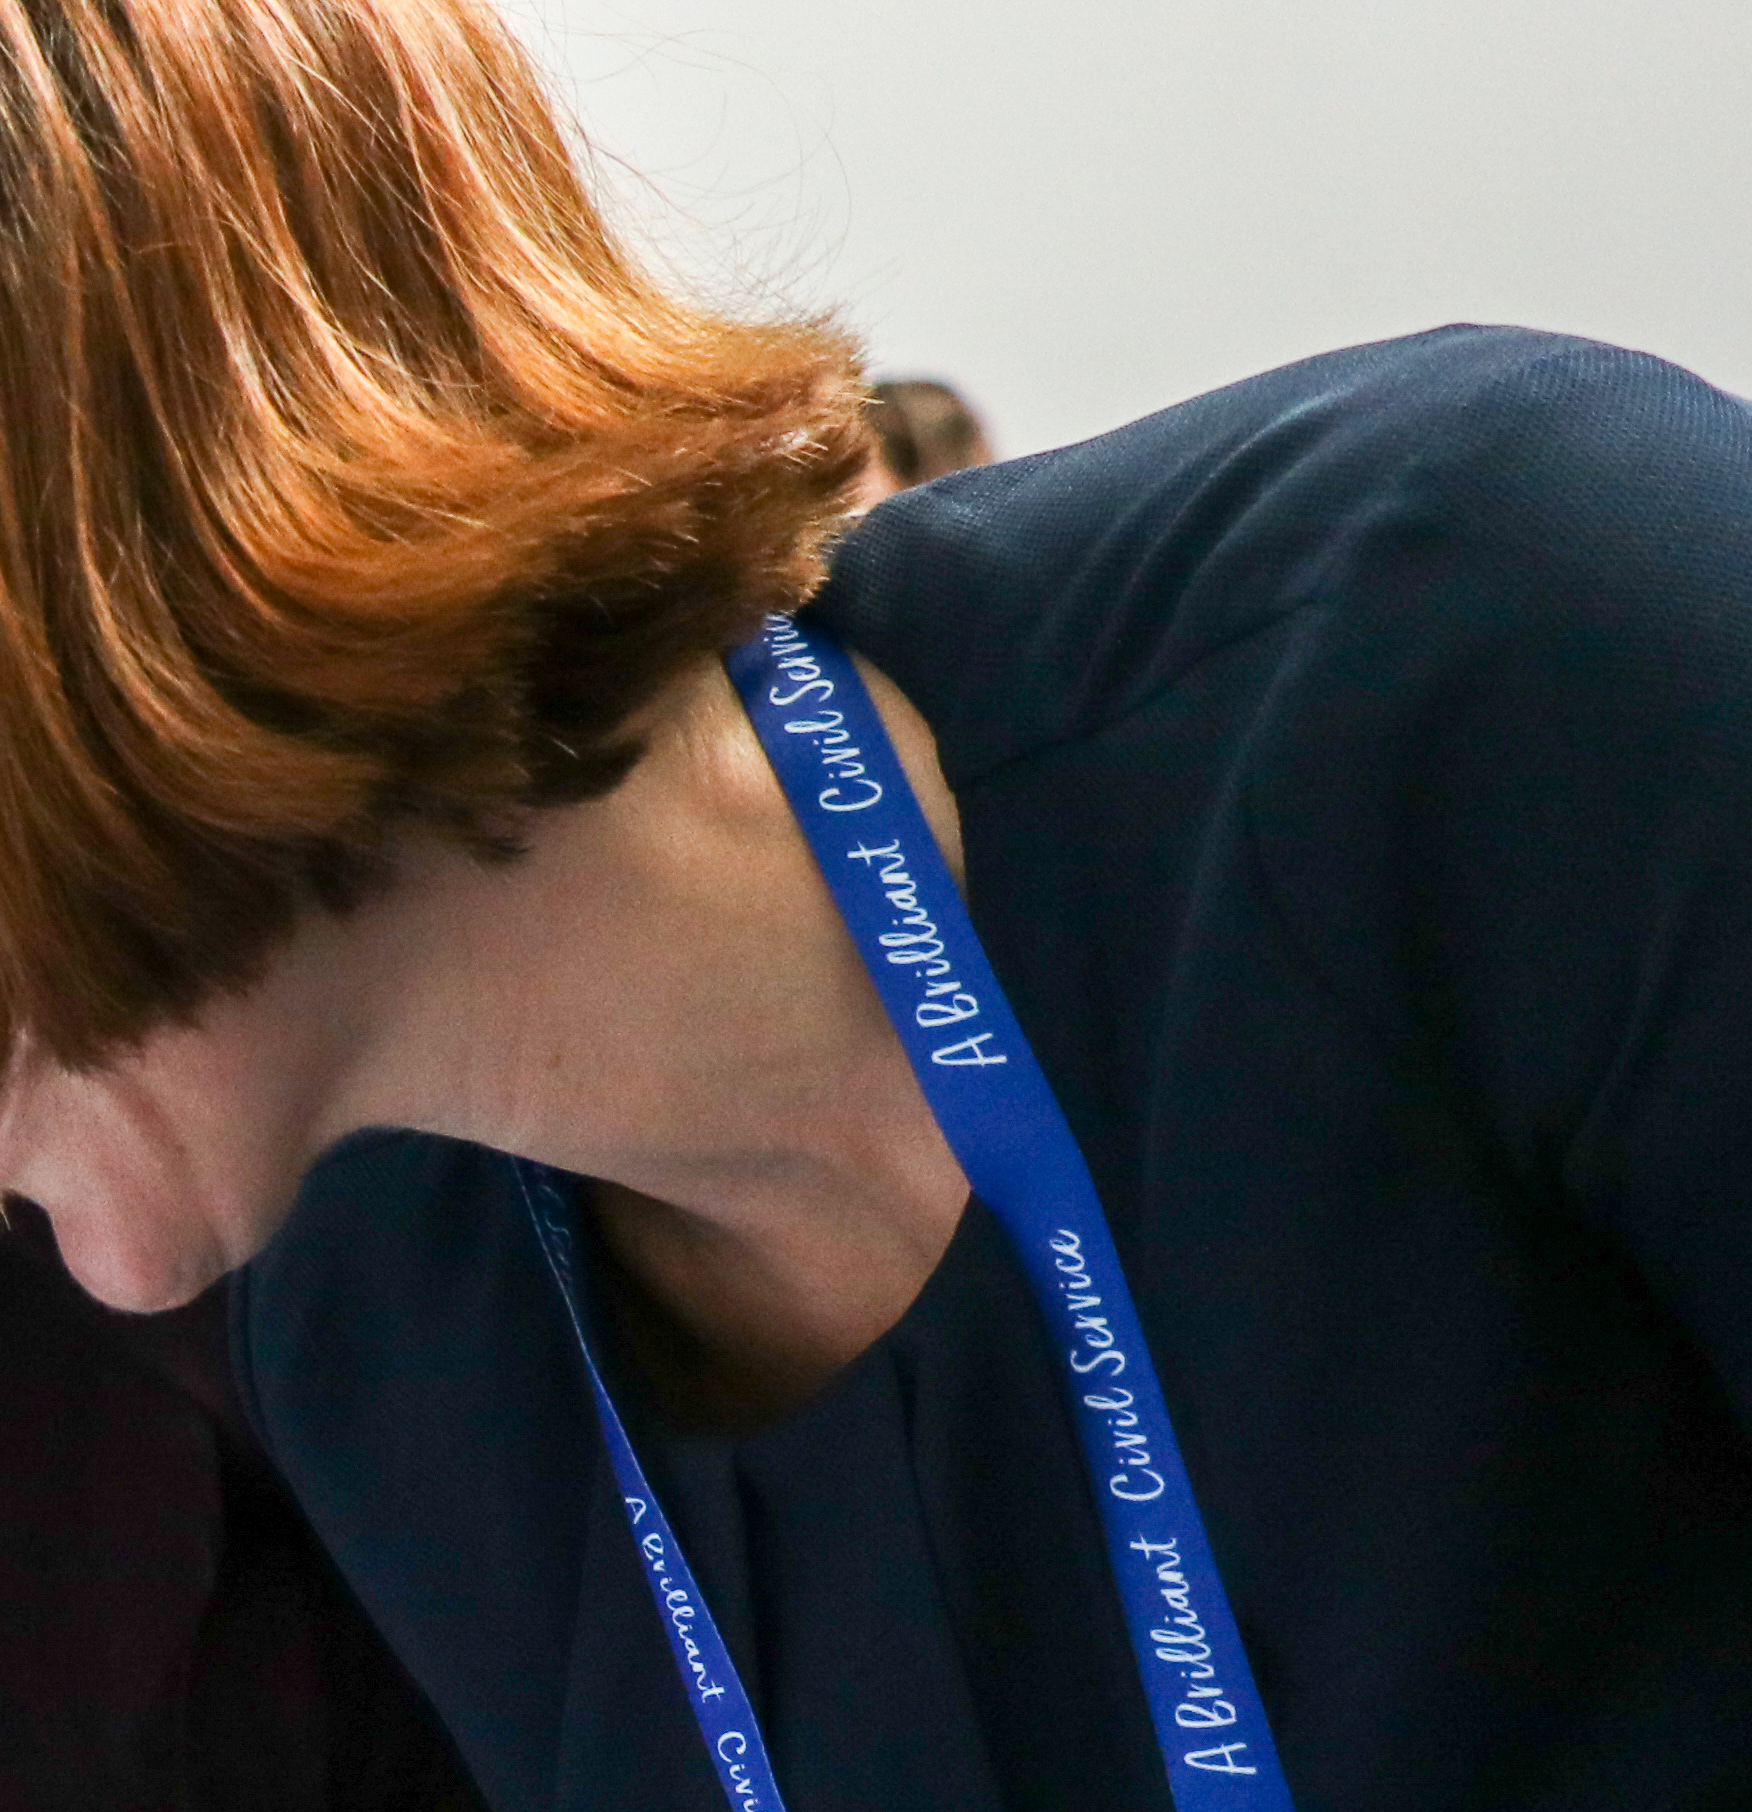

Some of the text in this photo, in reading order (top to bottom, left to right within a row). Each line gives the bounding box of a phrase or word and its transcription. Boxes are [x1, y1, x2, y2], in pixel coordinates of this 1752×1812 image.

[783, 695, 883, 812] Civil
[848, 837, 1165, 1501] A Brilliant Civil Service
[624, 1494, 647, 1527] A
[644, 1532, 725, 1705] Brilliant
[1132, 1535, 1238, 1733] Brilliant
[1183, 1740, 1256, 1778] A
